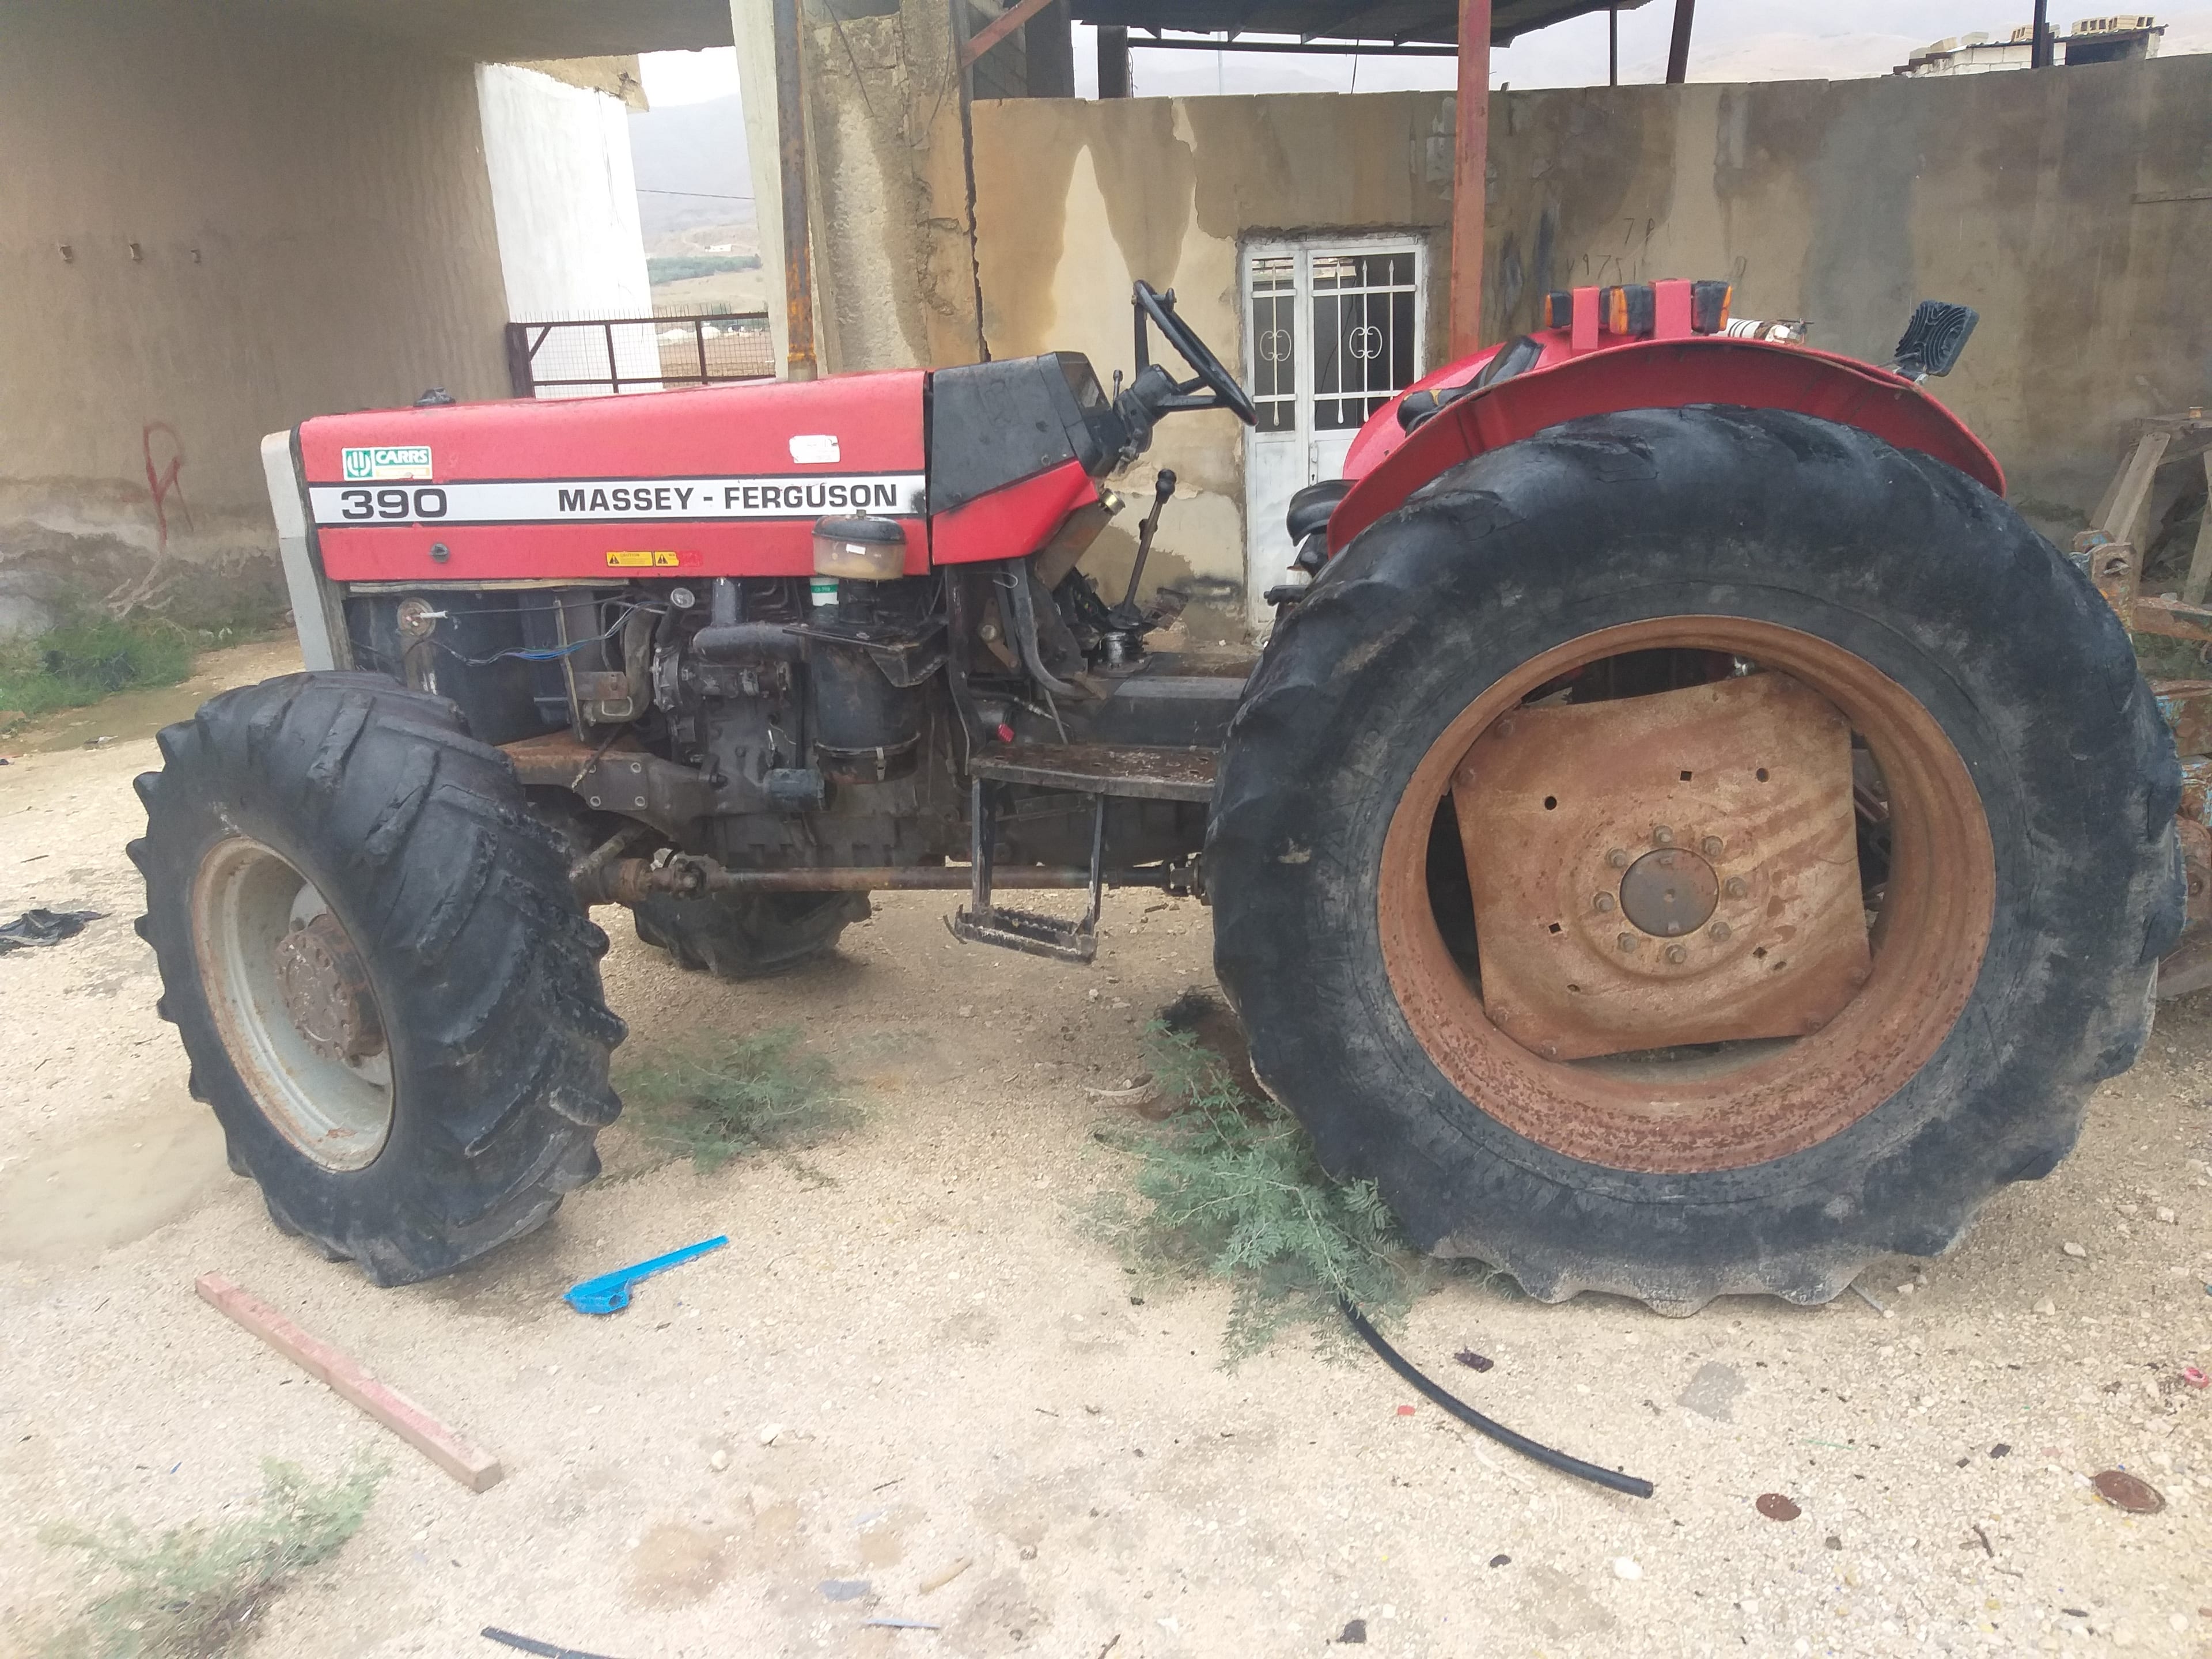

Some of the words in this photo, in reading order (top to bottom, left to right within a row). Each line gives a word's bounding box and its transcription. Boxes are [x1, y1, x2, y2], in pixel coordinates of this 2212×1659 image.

[376, 450, 428, 464] CARRS
[341, 488, 447, 519] 390
[558, 487, 694, 512] MASSEY
[724, 484, 897, 509] FERGUSON
